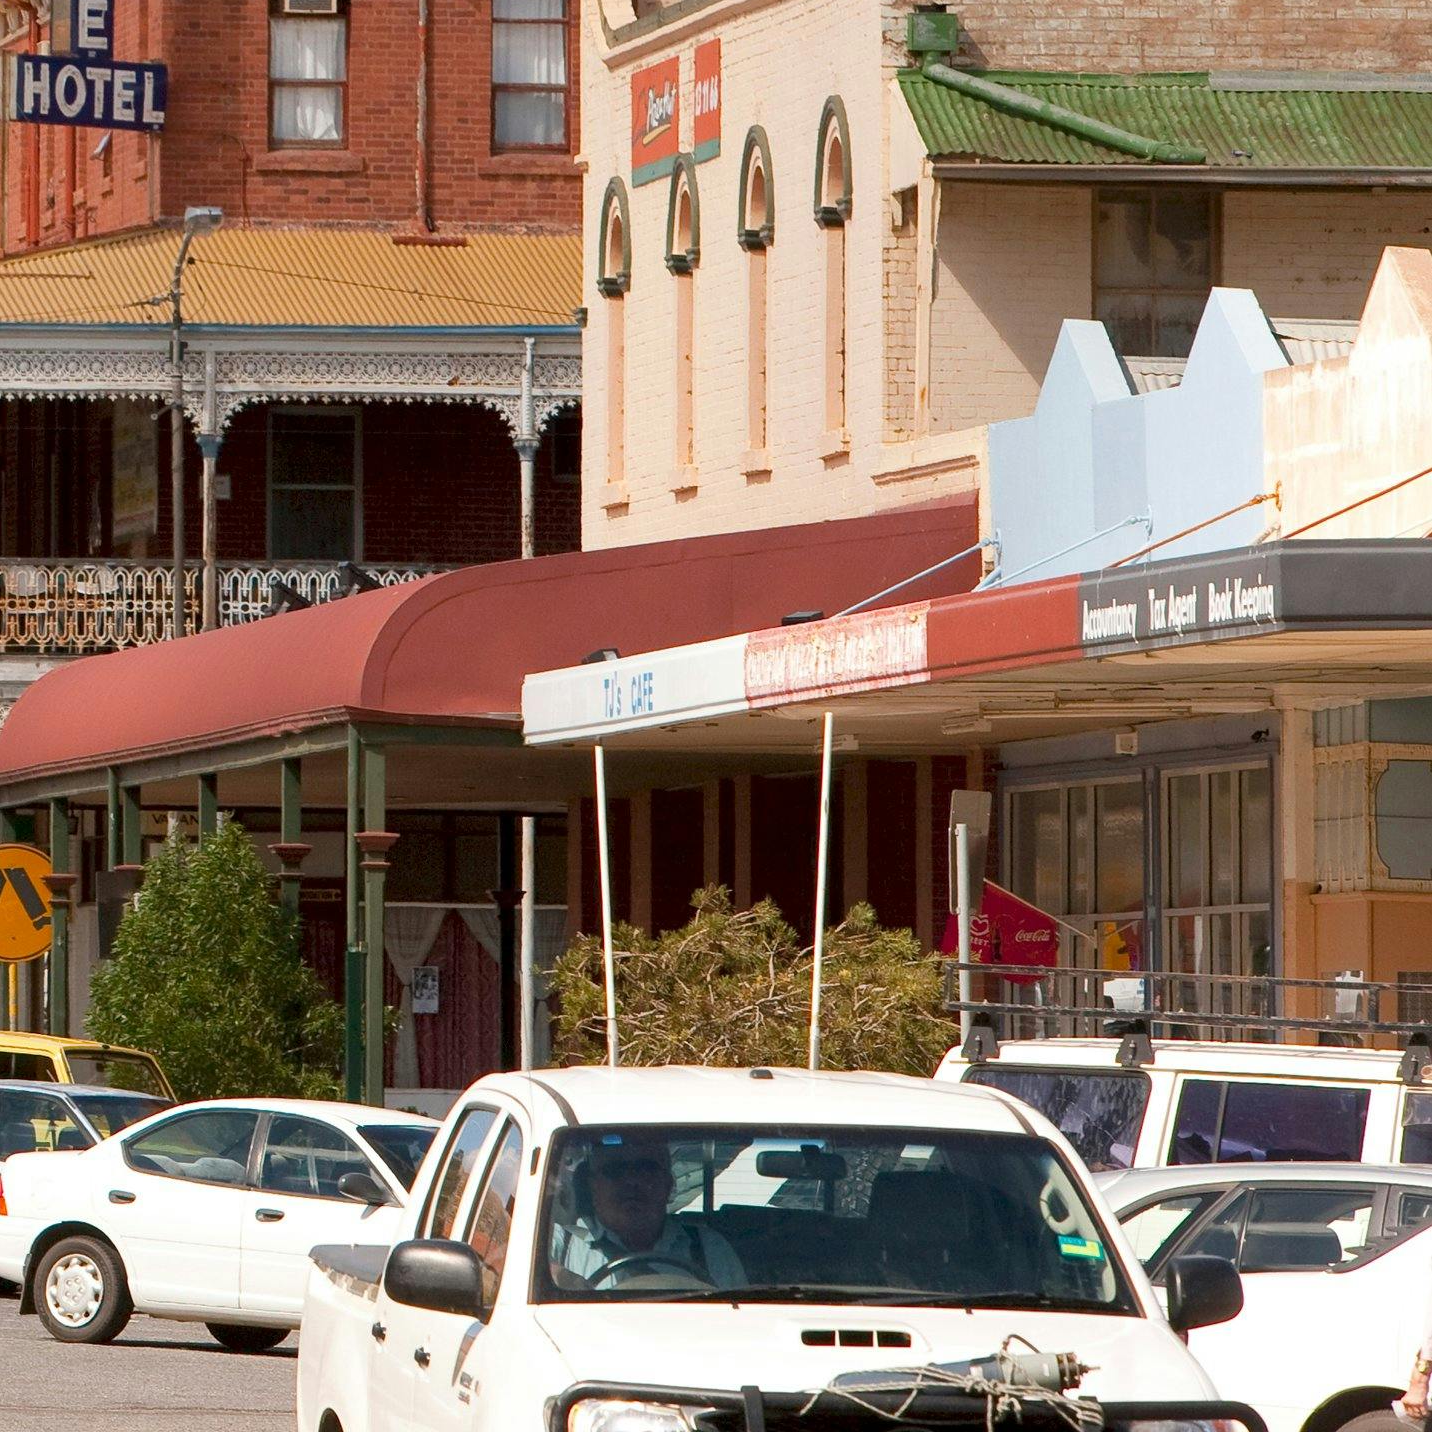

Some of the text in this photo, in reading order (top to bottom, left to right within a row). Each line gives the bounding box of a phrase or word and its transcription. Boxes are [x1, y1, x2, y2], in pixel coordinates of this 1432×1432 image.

[22, 61, 165, 125] HOTEL
[1083, 573, 1277, 644] Accountancy Tax Agent Book Keeping
[631, 672, 654, 715] CAFE
